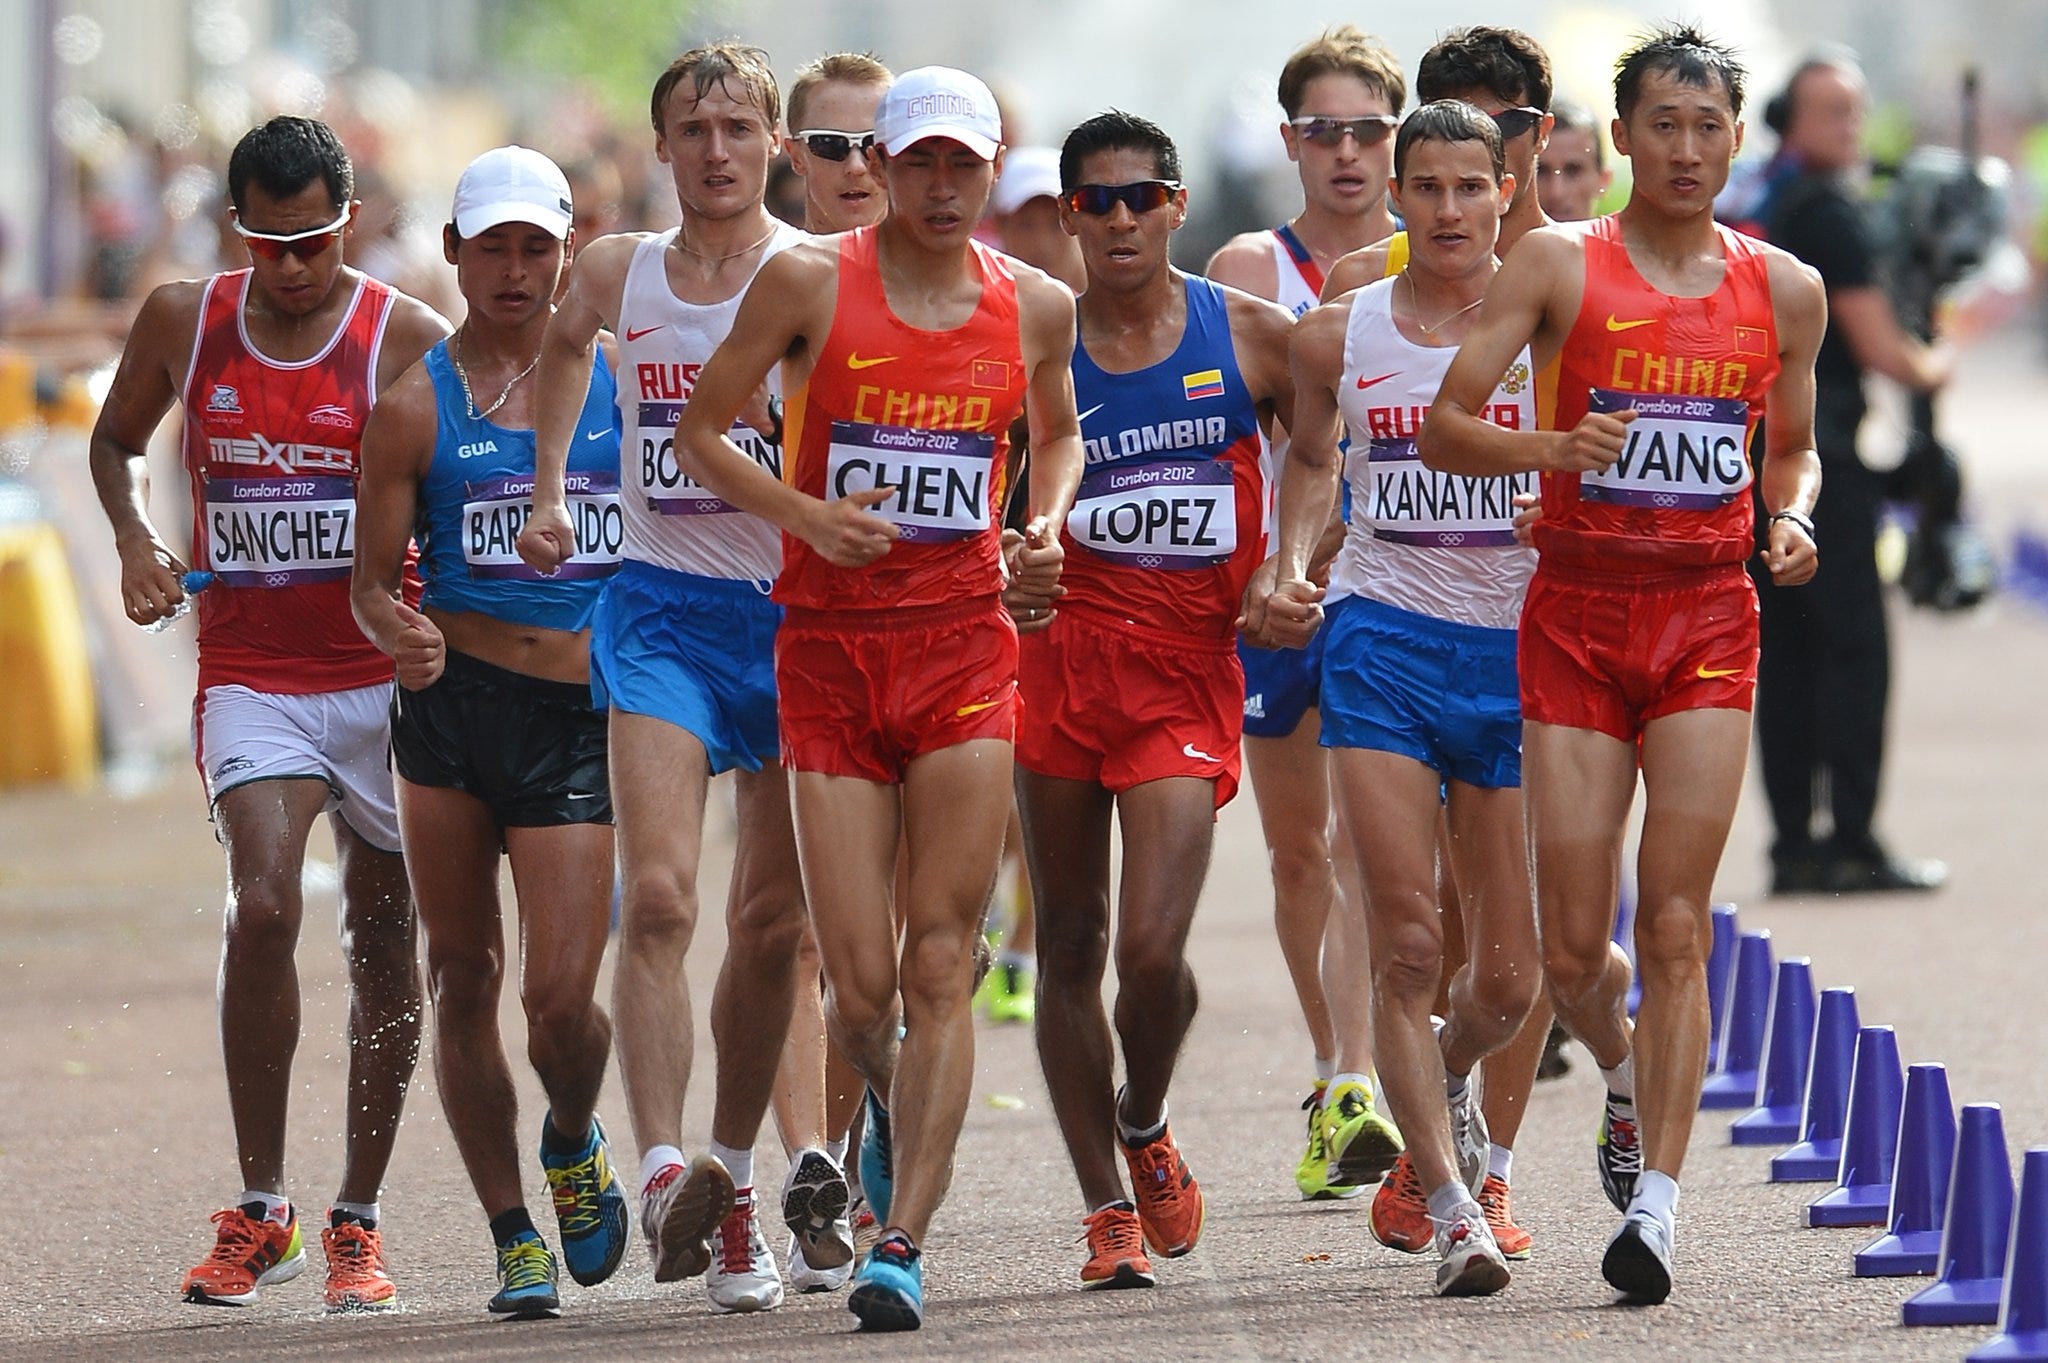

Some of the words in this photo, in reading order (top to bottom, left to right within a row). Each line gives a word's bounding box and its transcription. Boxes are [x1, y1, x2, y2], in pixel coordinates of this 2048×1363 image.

[907, 94, 976, 119] CHINA
[637, 363, 705, 400] RUS
[1611, 348, 1748, 398] CHINA
[308, 414, 353, 428] atletica
[853, 384, 992, 432] CHINA
[1367, 404, 1520, 440] RUA
[1684, 401, 1716, 417] 2012
[208, 432, 354, 475] MEXICO
[458, 440, 499, 459] GUA
[872, 429, 925, 448] London
[925, 434, 959, 450] 2012
[1084, 416, 1226, 465] OLOMBIA
[233, 483, 281, 498] London
[283, 482, 316, 496] 2012
[834, 459, 983, 520] CHEN
[1110, 470, 1160, 489] London
[1162, 467, 1196, 481] 2012
[214, 509, 354, 564] SANCHEZ
[1089, 499, 1218, 546] LOPEZ
